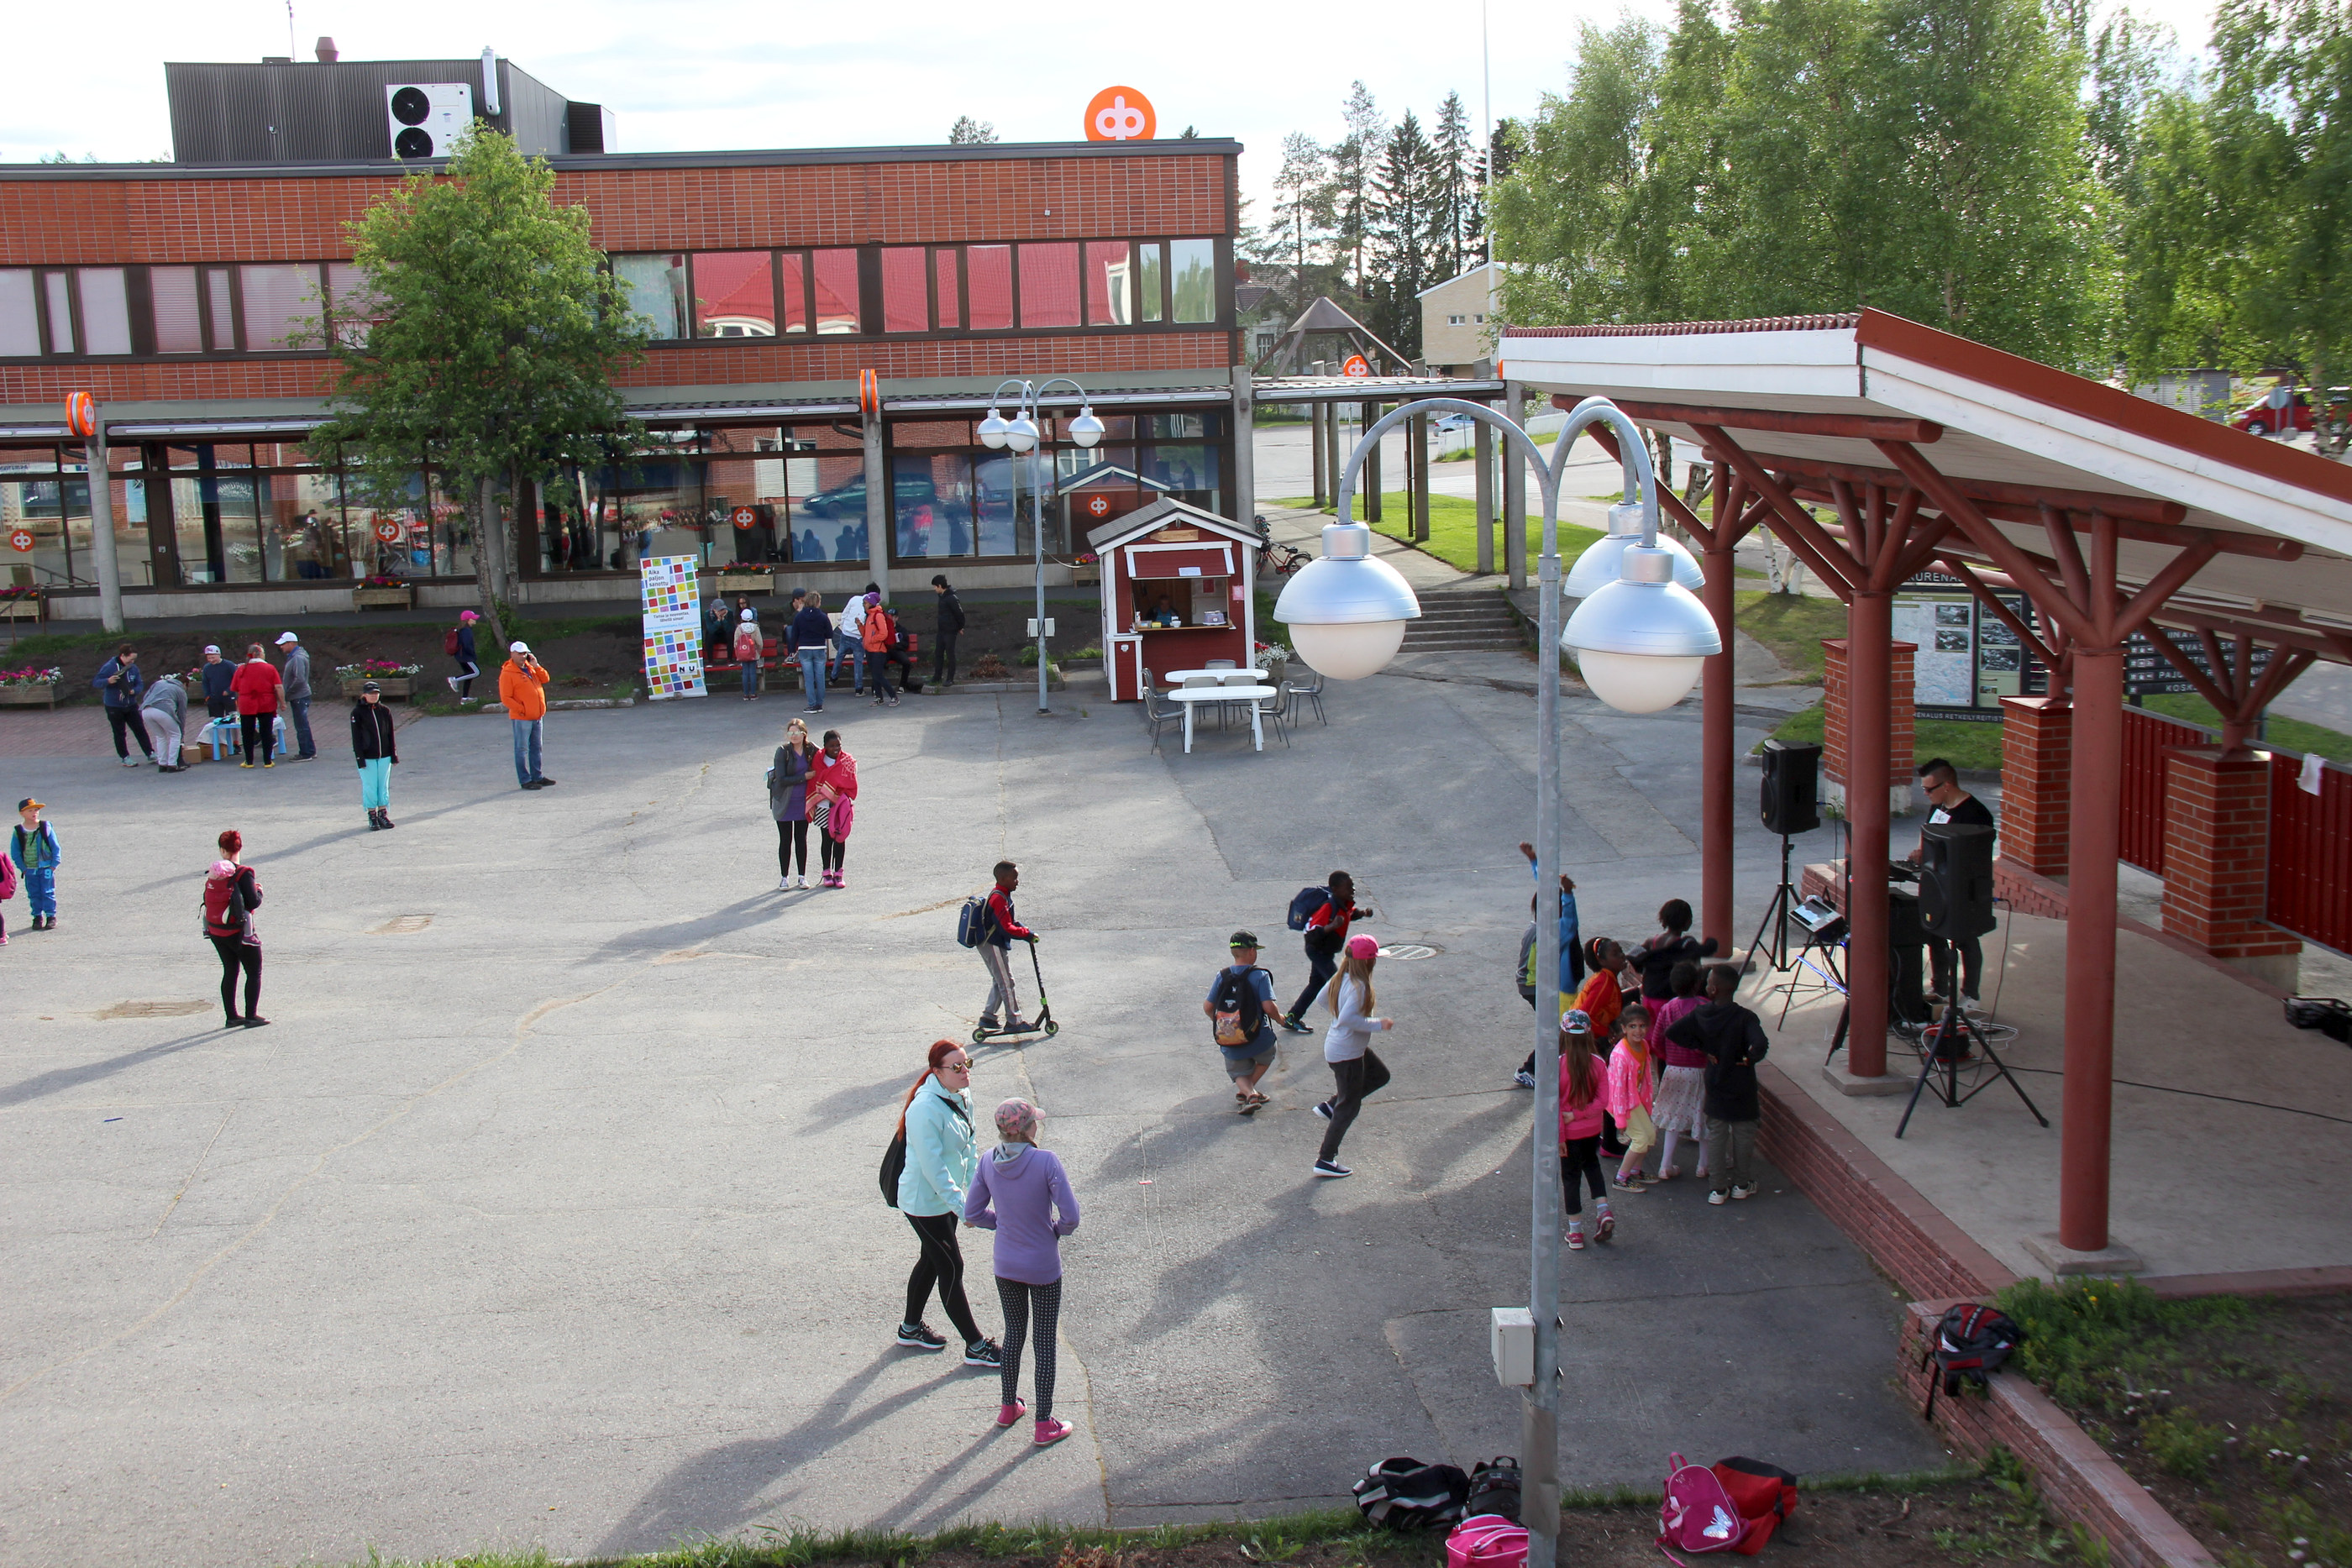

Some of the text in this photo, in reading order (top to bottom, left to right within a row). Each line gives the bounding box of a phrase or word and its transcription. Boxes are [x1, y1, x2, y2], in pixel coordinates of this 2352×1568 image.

[1908, 572, 1963, 583] URENA
[1945, 713, 2003, 722] RETKEILYREITIST
[45, 869, 52, 878] 9
